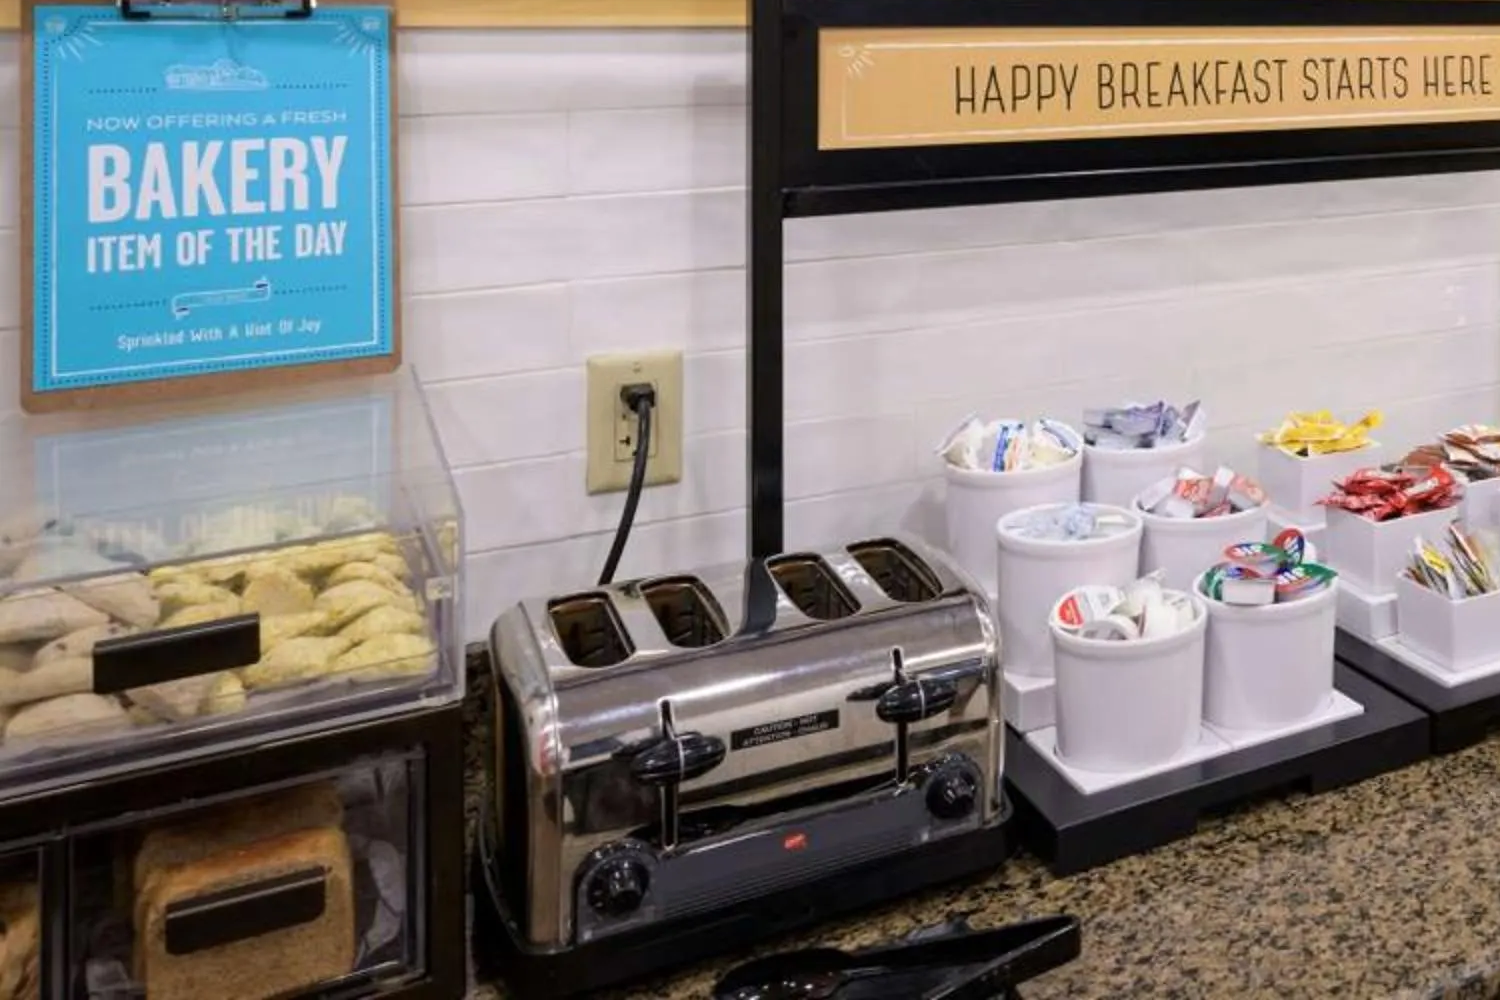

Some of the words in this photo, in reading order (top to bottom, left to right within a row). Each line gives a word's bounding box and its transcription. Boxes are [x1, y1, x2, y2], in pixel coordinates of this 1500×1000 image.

[954, 63, 1079, 115] HAPPY
[1097, 58, 1288, 110] BREAKFAST
[1302, 56, 1409, 101] STARTS
[1422, 53, 1493, 97] HERE
[87, 116, 141, 132] NOW
[146, 111, 257, 130] OFFERING
[262, 112, 277, 126] A
[281, 109, 348, 125] FRESH
[87, 135, 348, 224] BAKERY
[87, 233, 162, 274] ITEM
[176, 229, 215, 266] OF
[226, 225, 282, 262] THE
[295, 221, 348, 257] DAY
[190, 326, 224, 343] With
[229, 324, 240, 339] A
[299, 318, 322, 336] Joy
